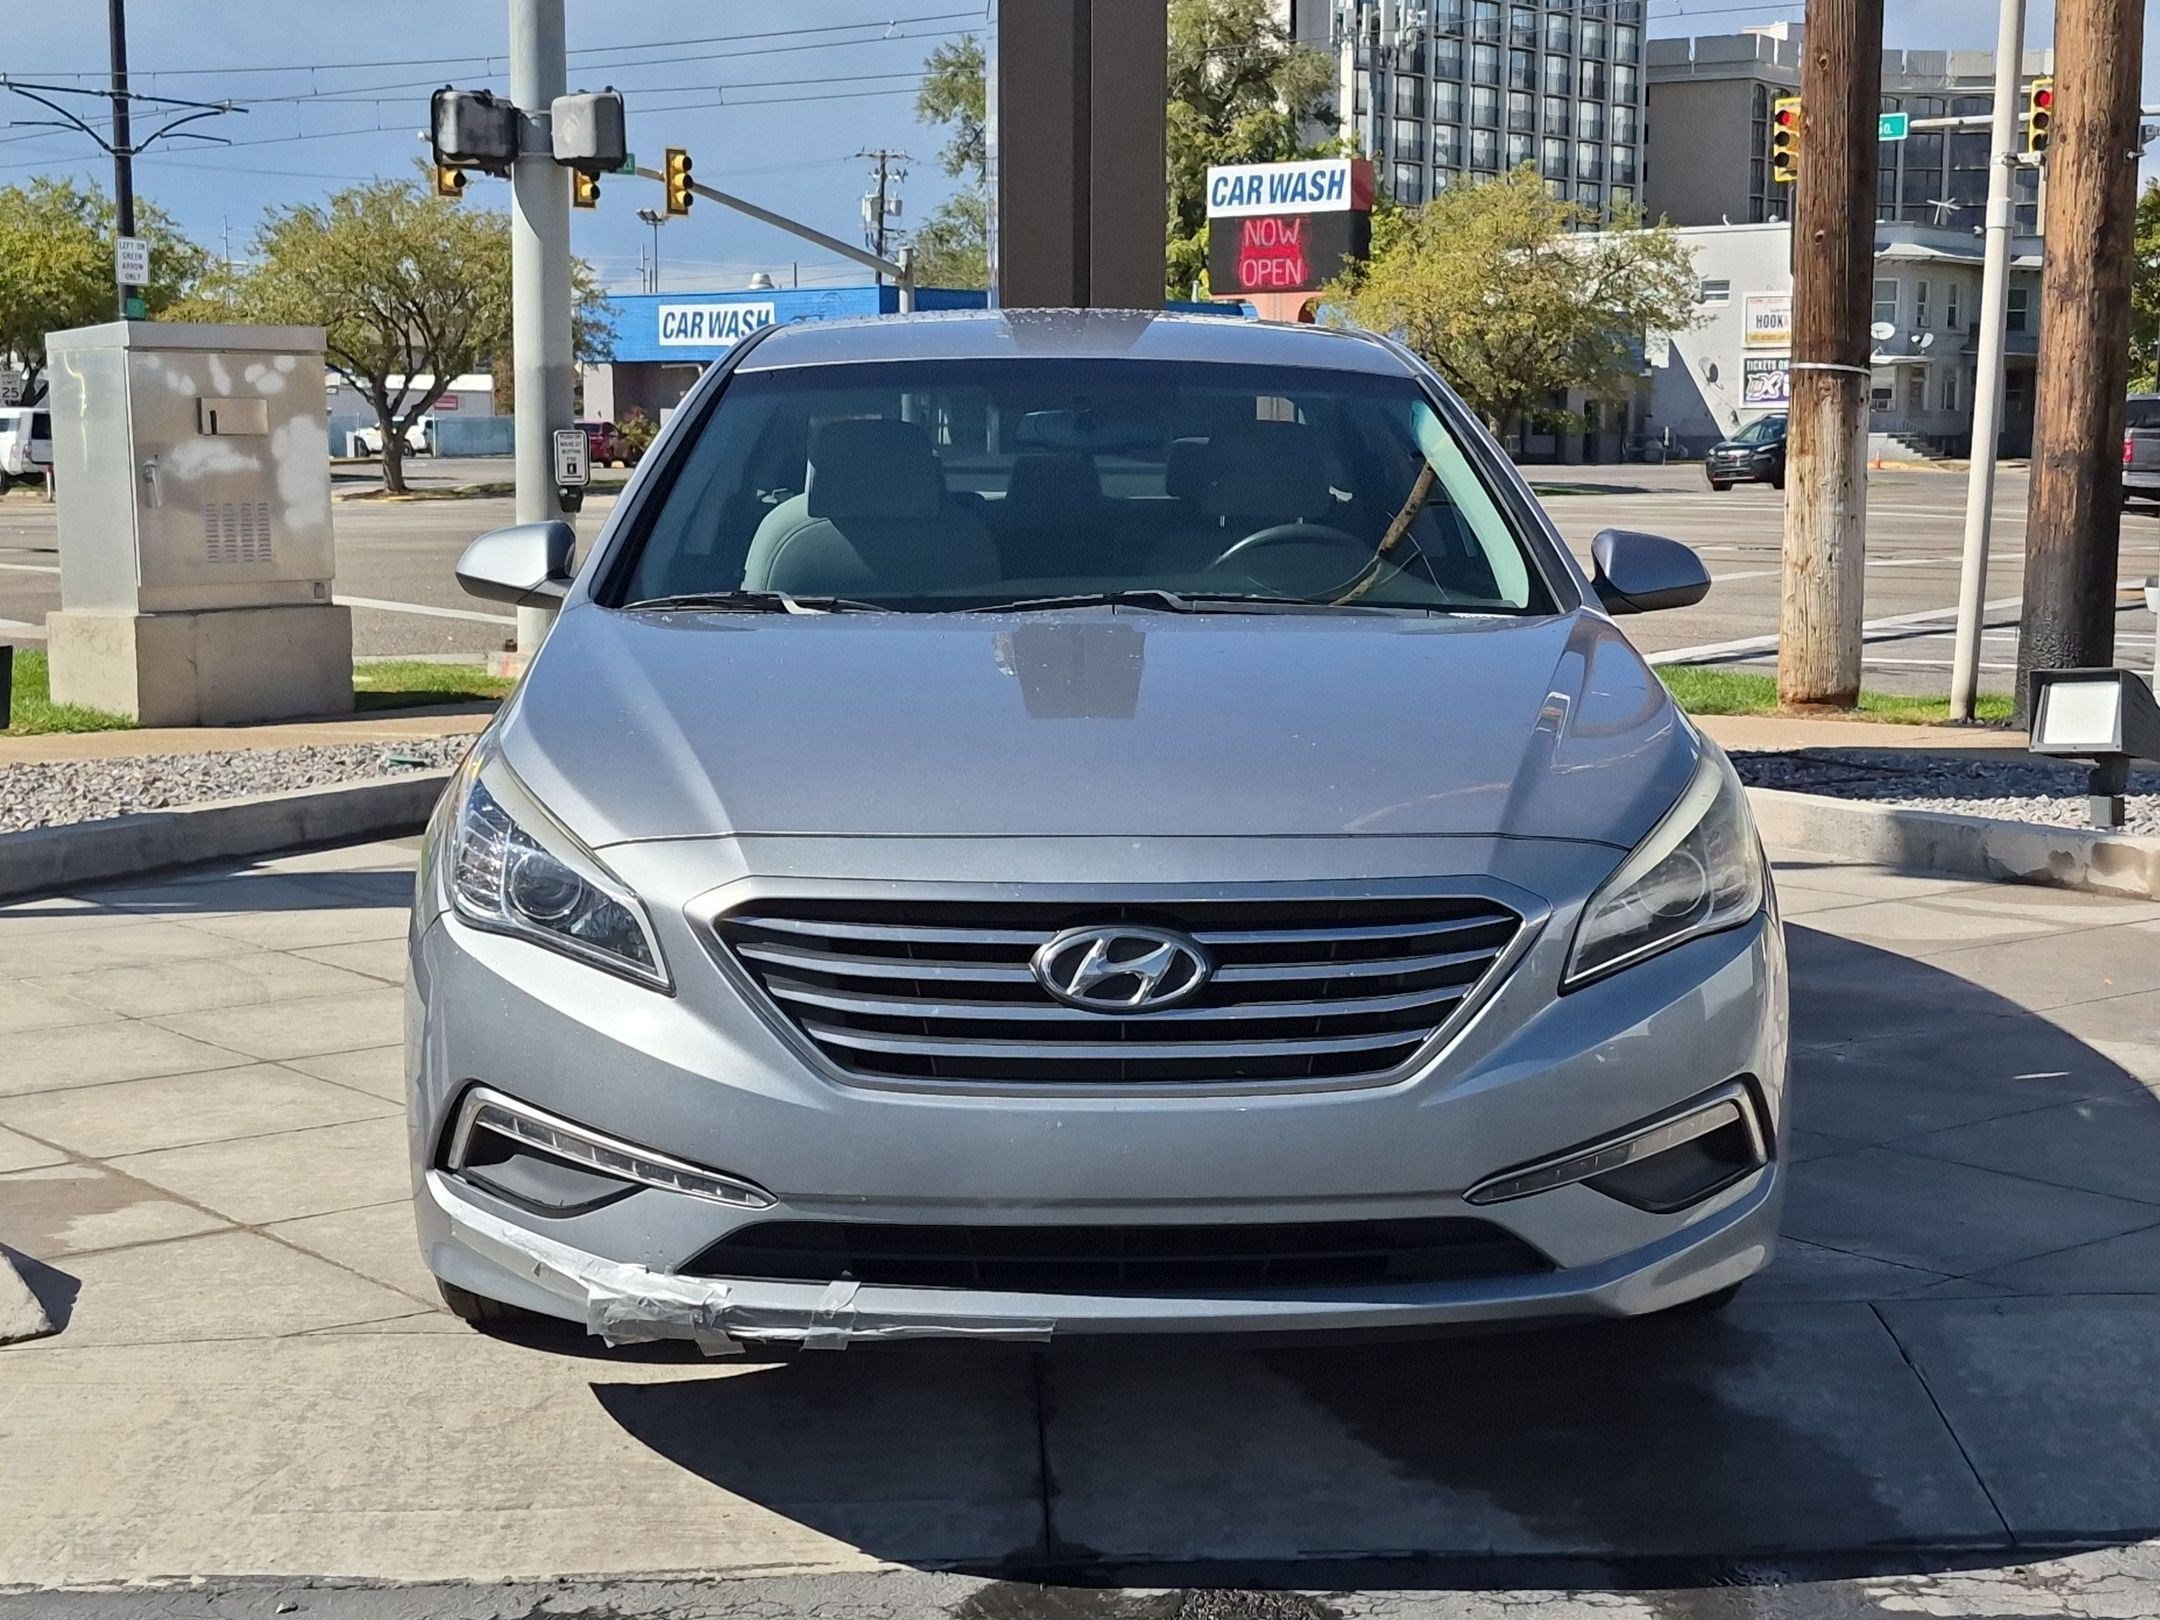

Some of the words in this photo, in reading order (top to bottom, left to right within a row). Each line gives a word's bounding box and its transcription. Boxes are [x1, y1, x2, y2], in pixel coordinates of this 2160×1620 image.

[1212, 174, 1264, 207] CAR
[1269, 169, 1346, 204] WASH
[1244, 218, 1300, 246] NOW
[1242, 258, 1301, 287] OPEN
[663, 311, 704, 339] CAR
[708, 309, 770, 339] WASH
[2, 387, 19, 399] 25
